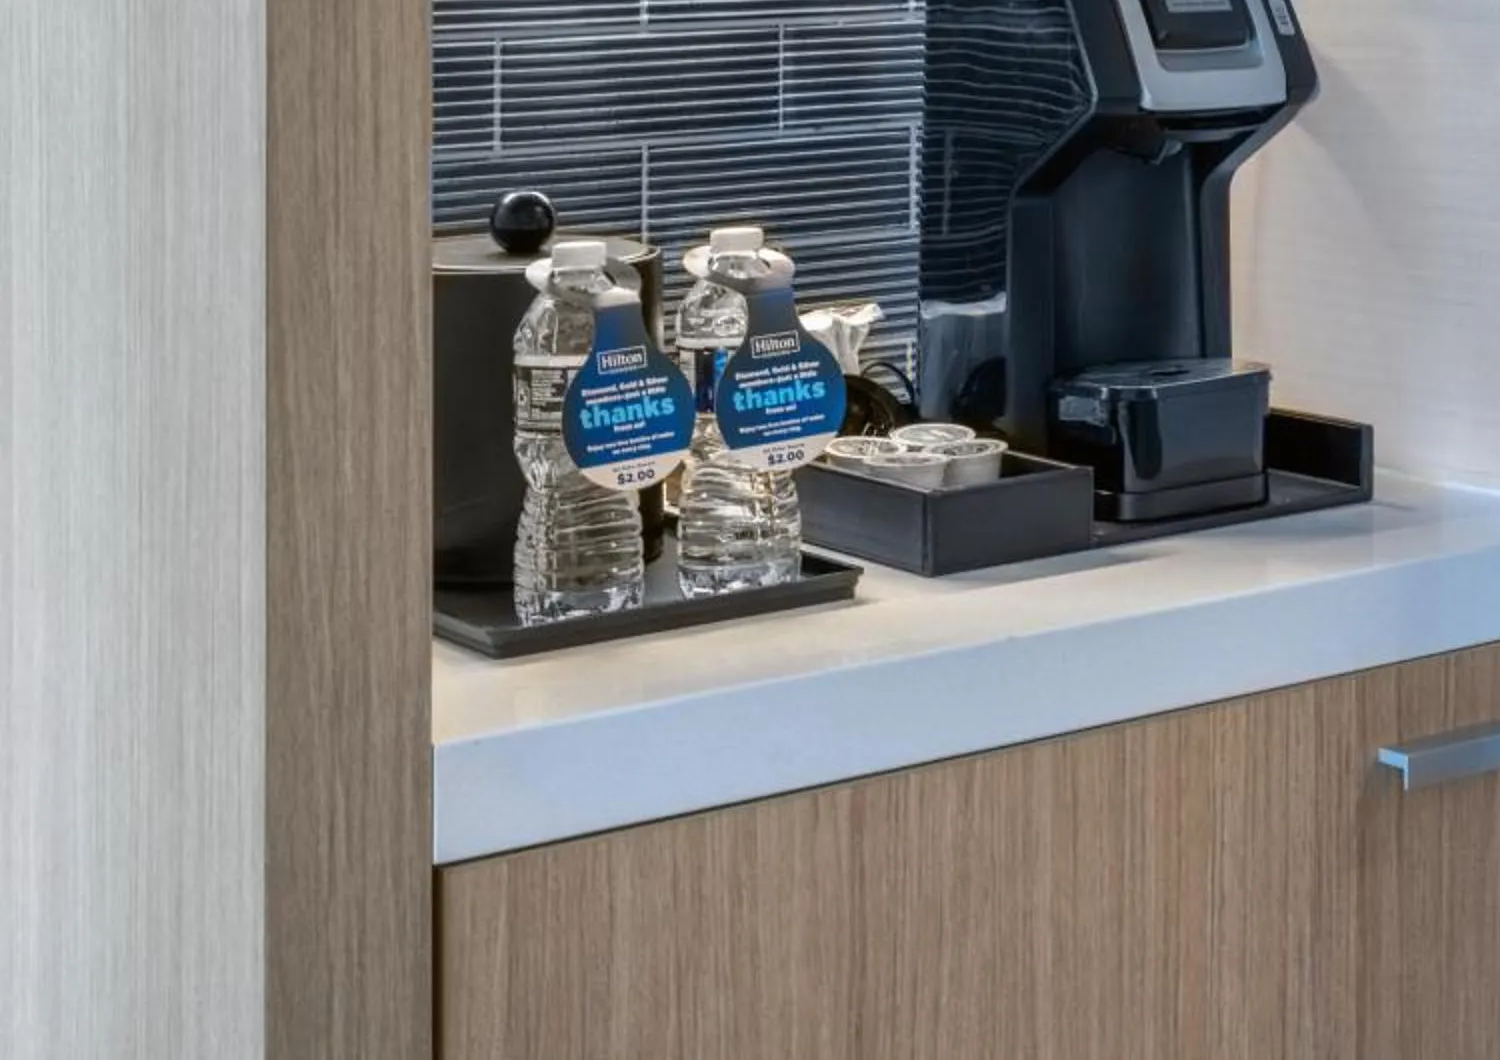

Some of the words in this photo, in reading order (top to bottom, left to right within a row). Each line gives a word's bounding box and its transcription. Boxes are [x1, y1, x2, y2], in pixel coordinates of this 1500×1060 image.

[754, 337, 796, 354] Hilton
[601, 353, 643, 370] Hilton
[733, 380, 827, 413] thanks
[579, 395, 675, 429] thanks
[767, 449, 806, 466] $2.00
[617, 468, 656, 485] $2.00
